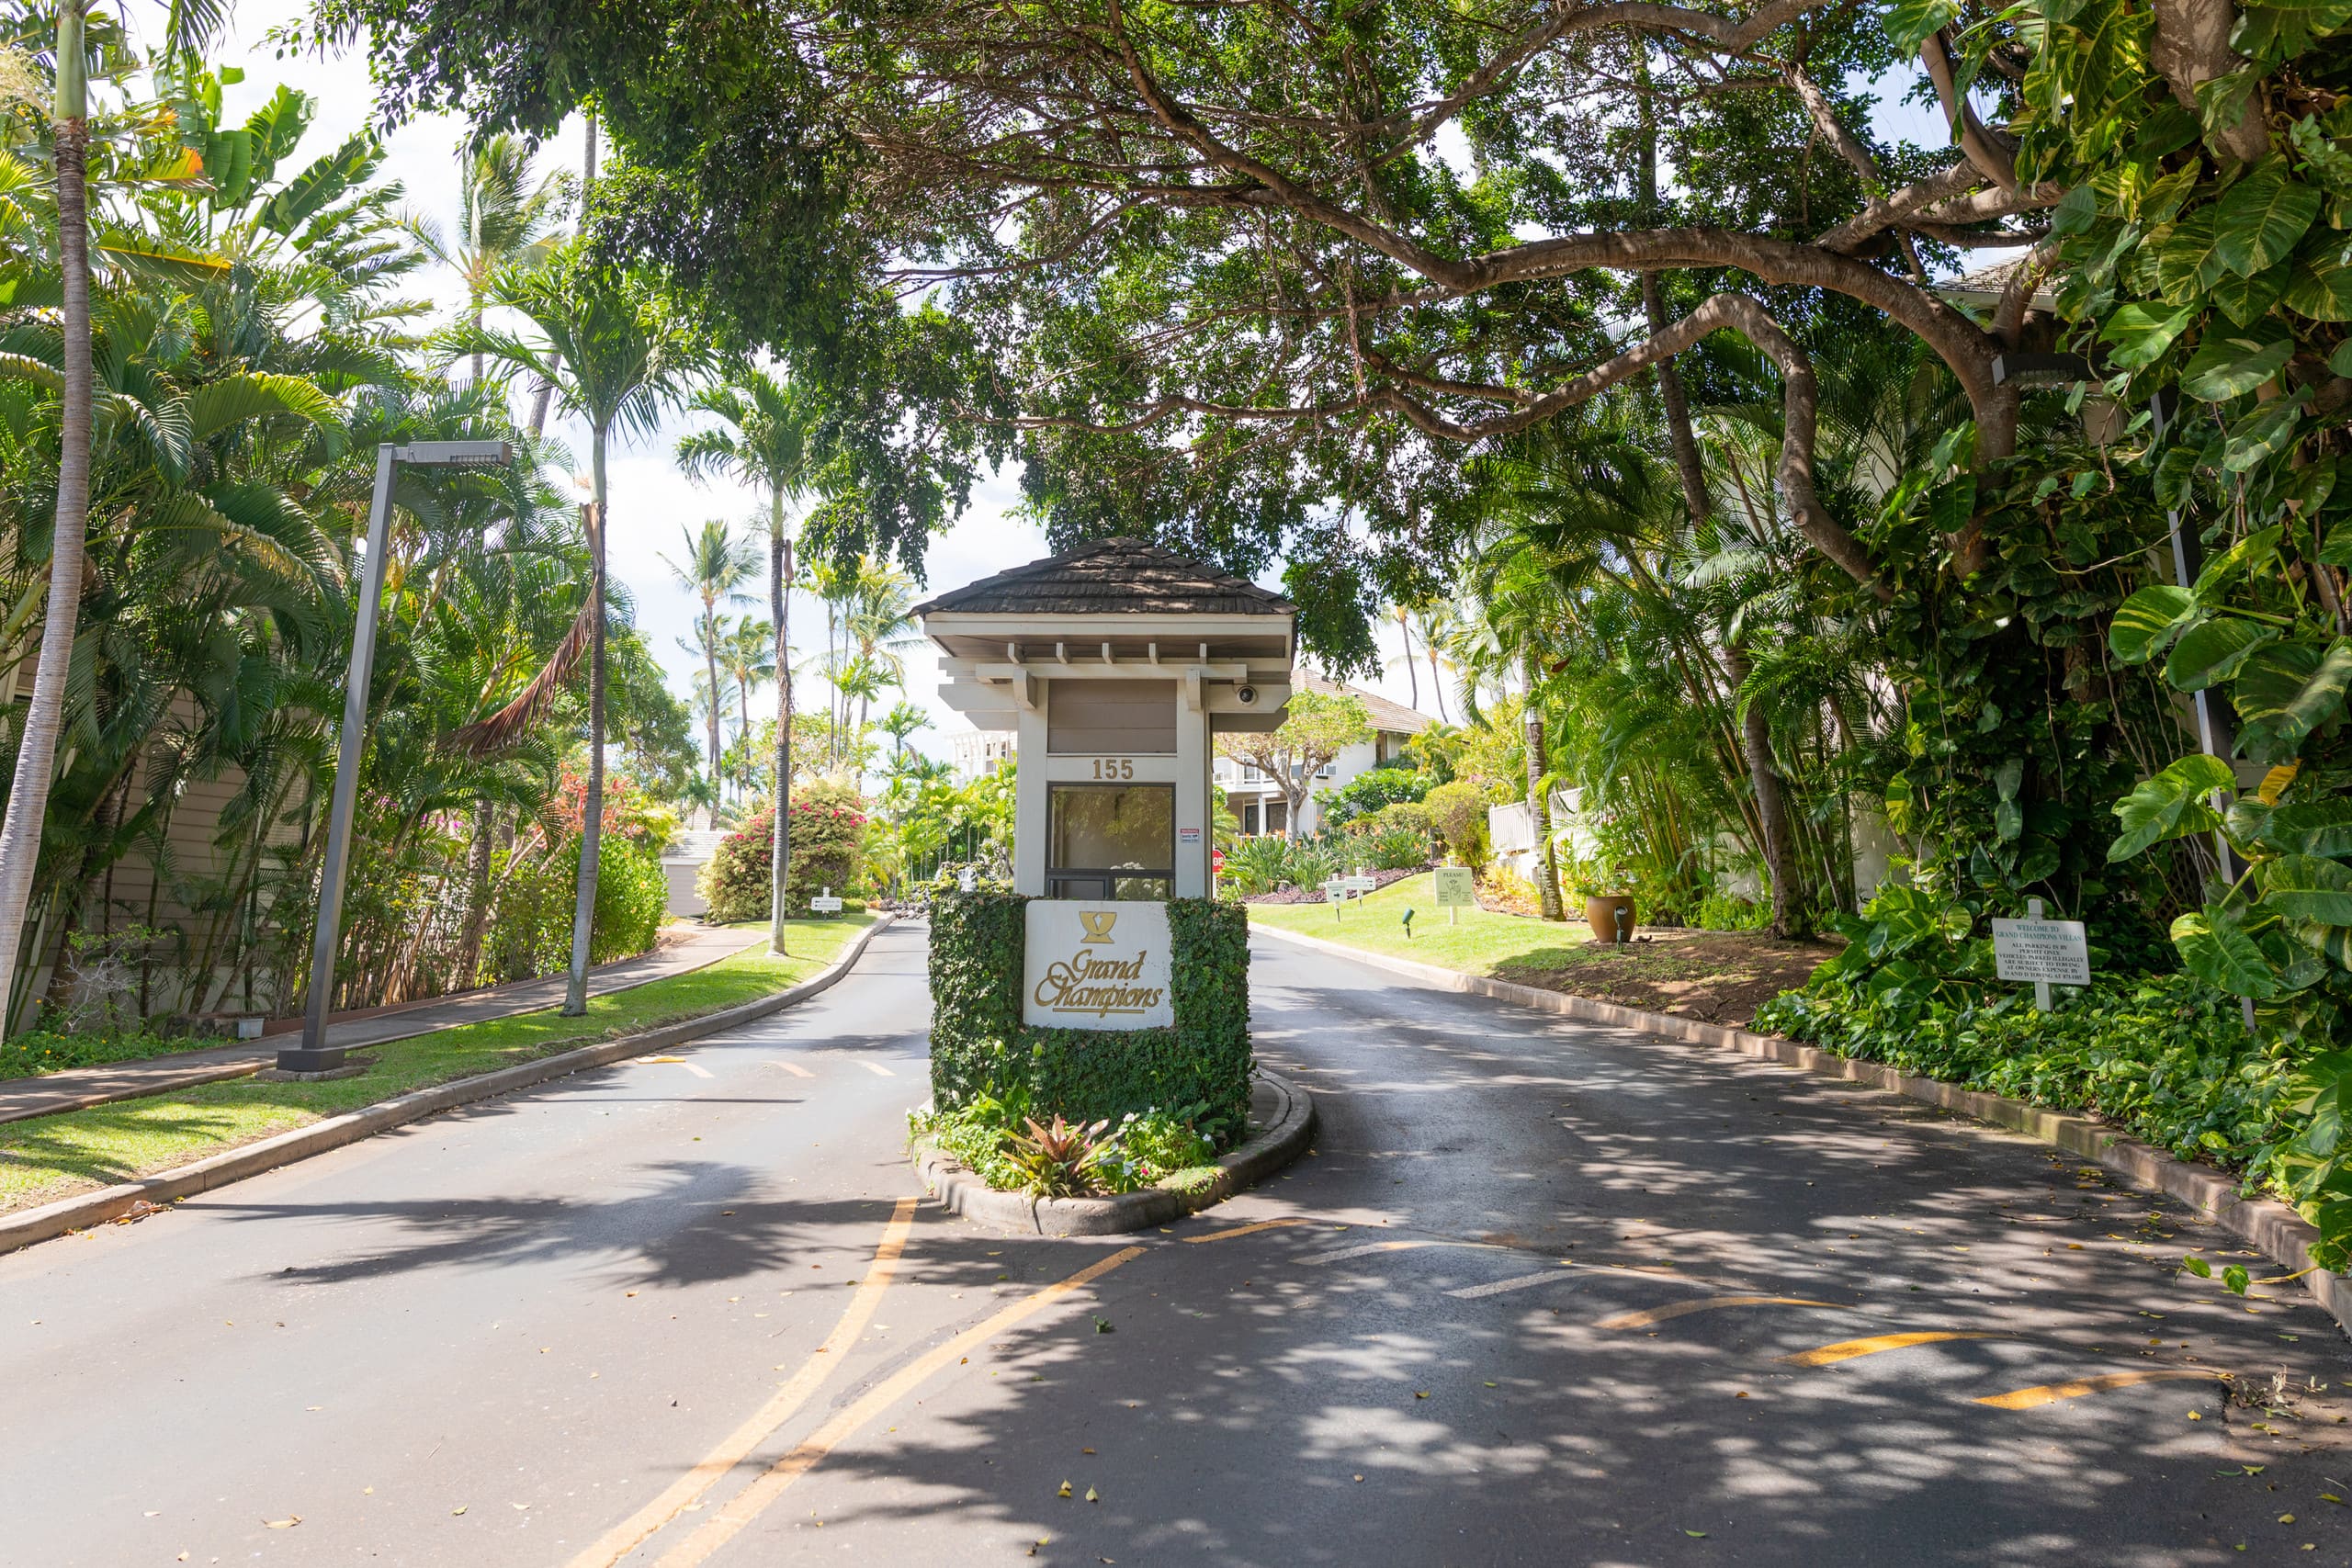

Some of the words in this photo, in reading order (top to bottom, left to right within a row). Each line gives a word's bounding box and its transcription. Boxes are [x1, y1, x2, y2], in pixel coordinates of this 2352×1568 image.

[1093, 759, 1133, 779] 155
[1213, 857, 1225, 867] OP
[2016, 924, 2049, 932] WELCOME
[1047, 949, 1147, 988] Grand
[1034, 972, 1163, 1018] Champions
